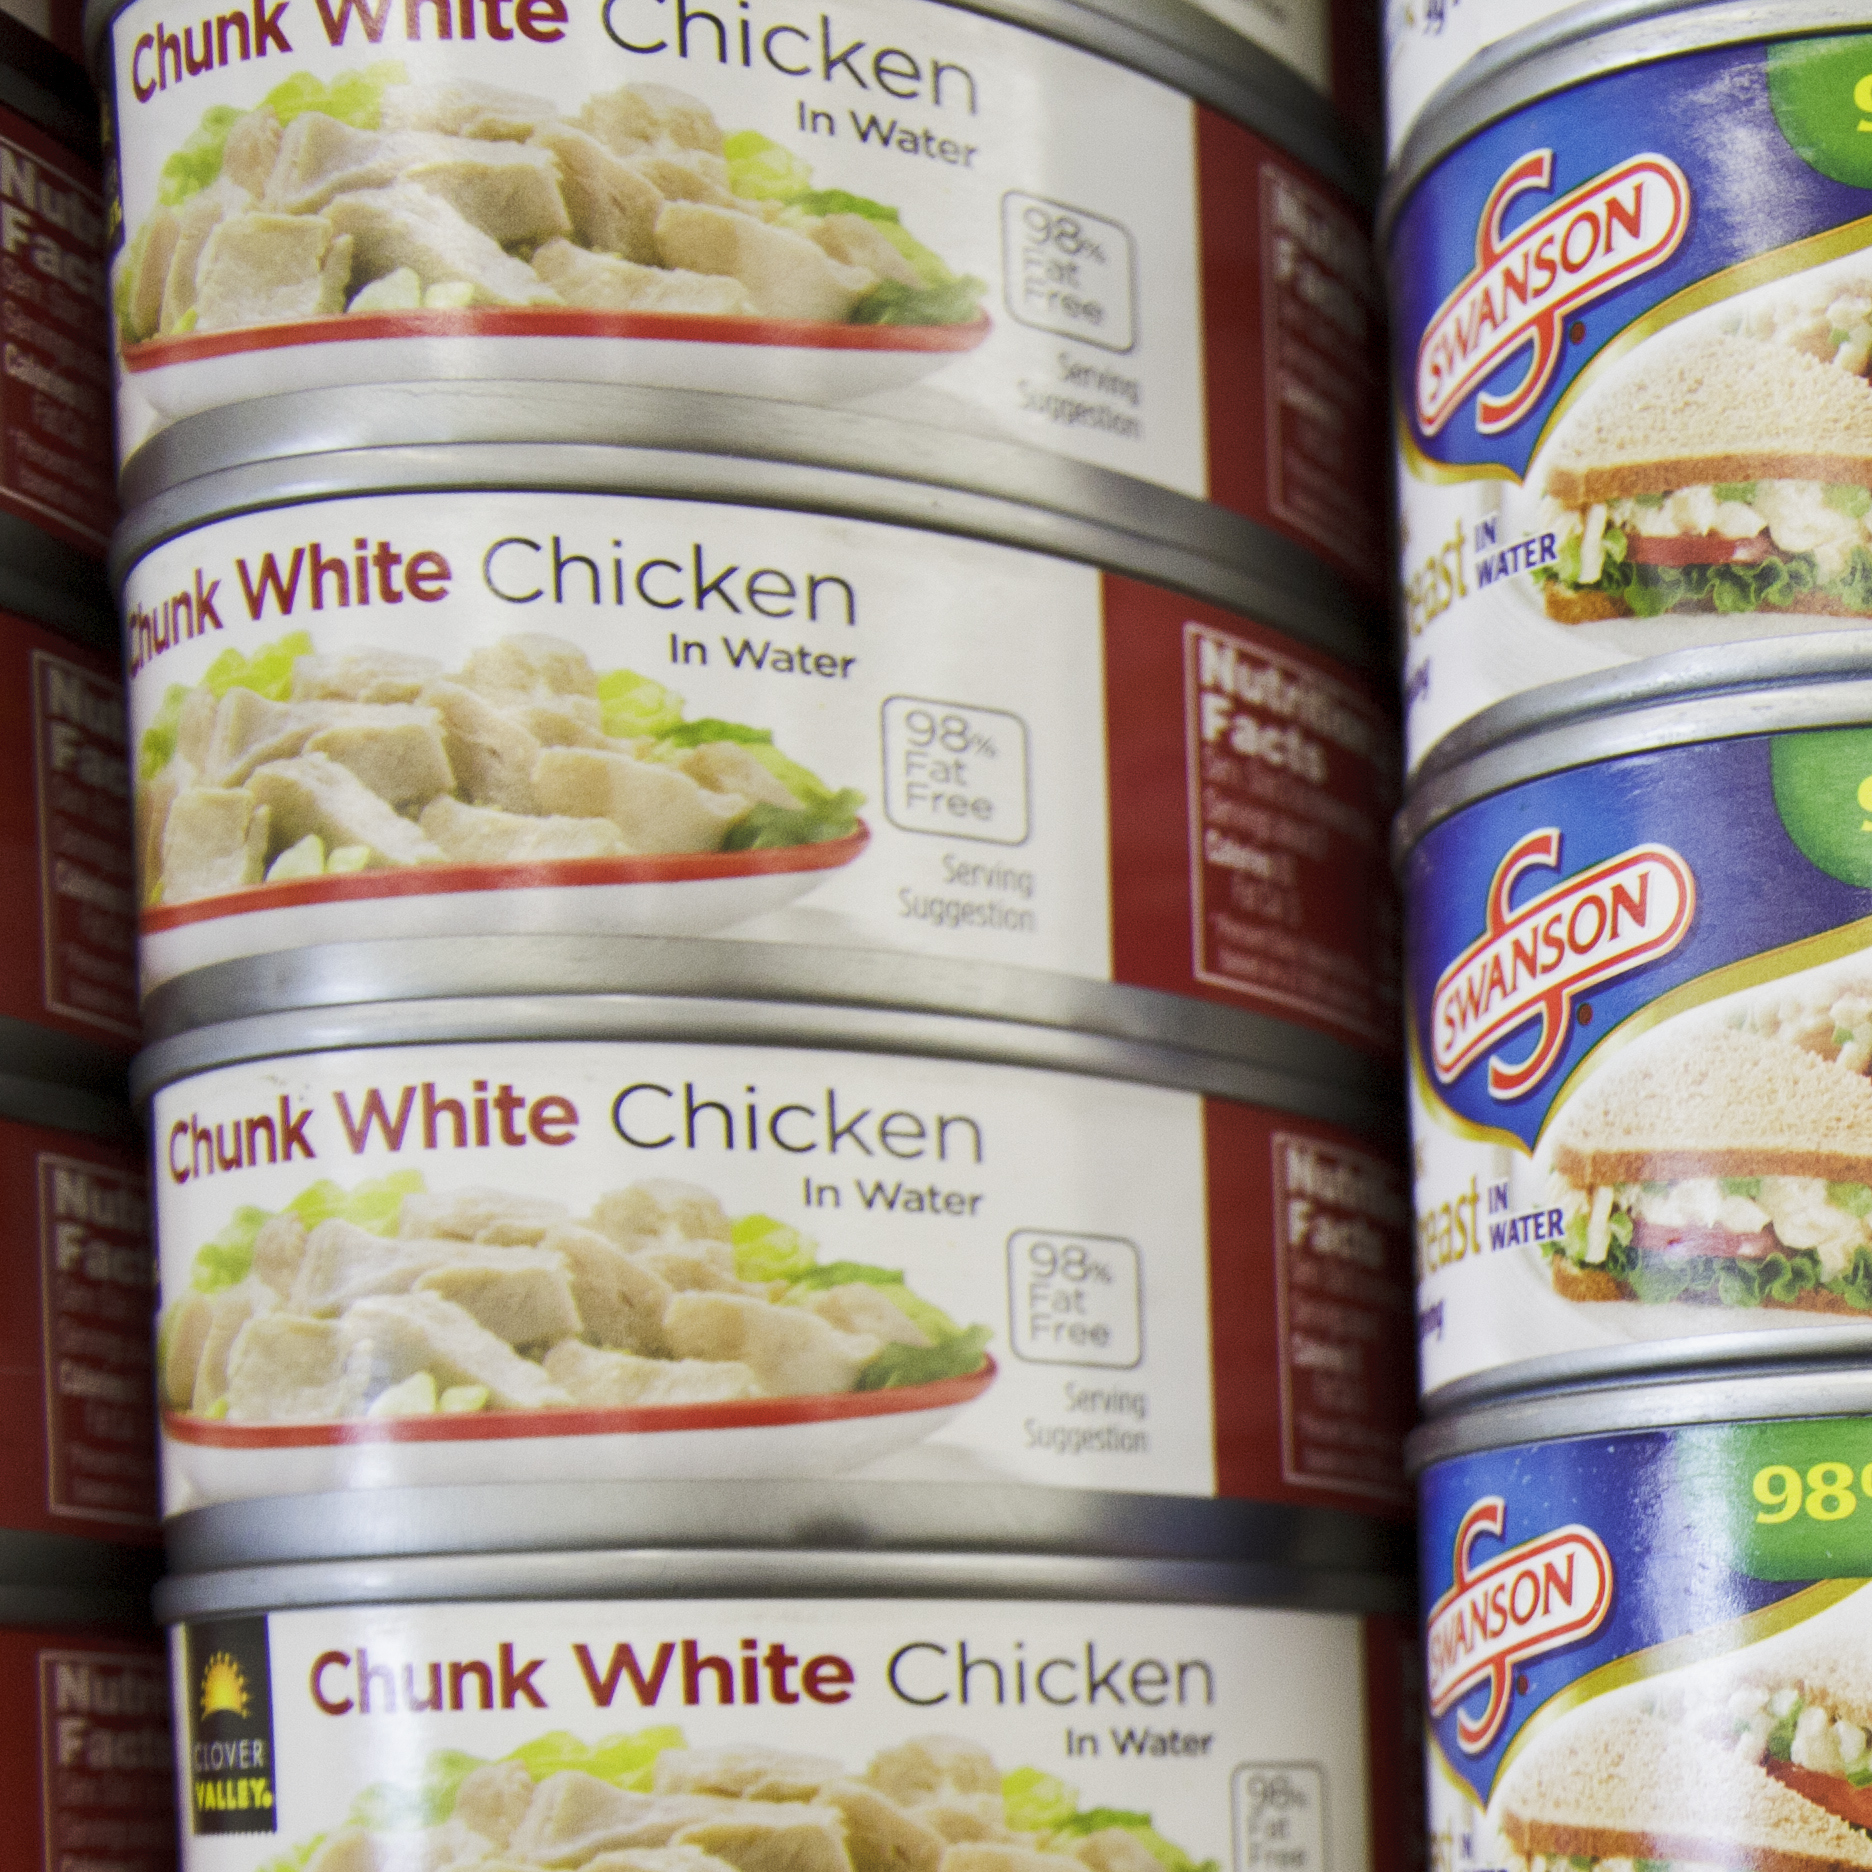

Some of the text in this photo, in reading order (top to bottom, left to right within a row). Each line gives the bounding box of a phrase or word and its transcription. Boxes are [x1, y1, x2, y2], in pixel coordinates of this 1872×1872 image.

[1424, 186, 1645, 399] SWANSON
[1440, 868, 1648, 1052] SWANSON
[169, 1083, 985, 1185] Chunk White Chicken
[309, 1641, 1217, 1716] Chunk White Chicken
